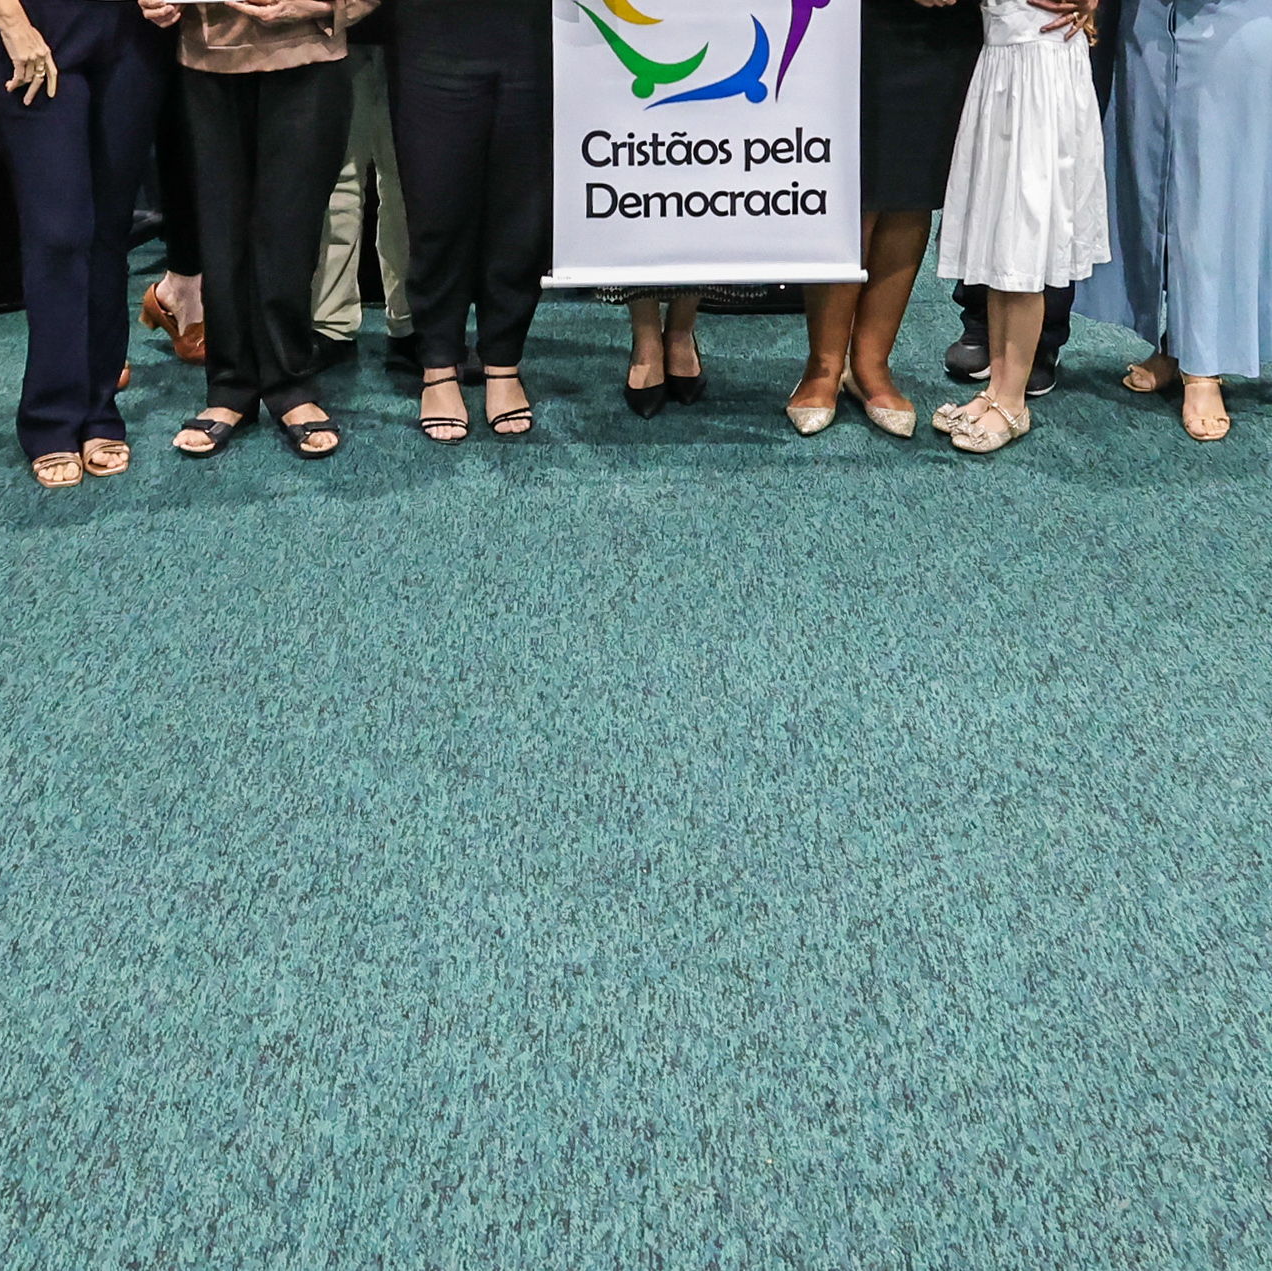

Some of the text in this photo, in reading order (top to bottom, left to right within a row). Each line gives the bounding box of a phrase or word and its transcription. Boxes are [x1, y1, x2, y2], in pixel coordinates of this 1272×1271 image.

[581, 127, 831, 172] Cristãos pela
[585, 181, 827, 219] Democracia
